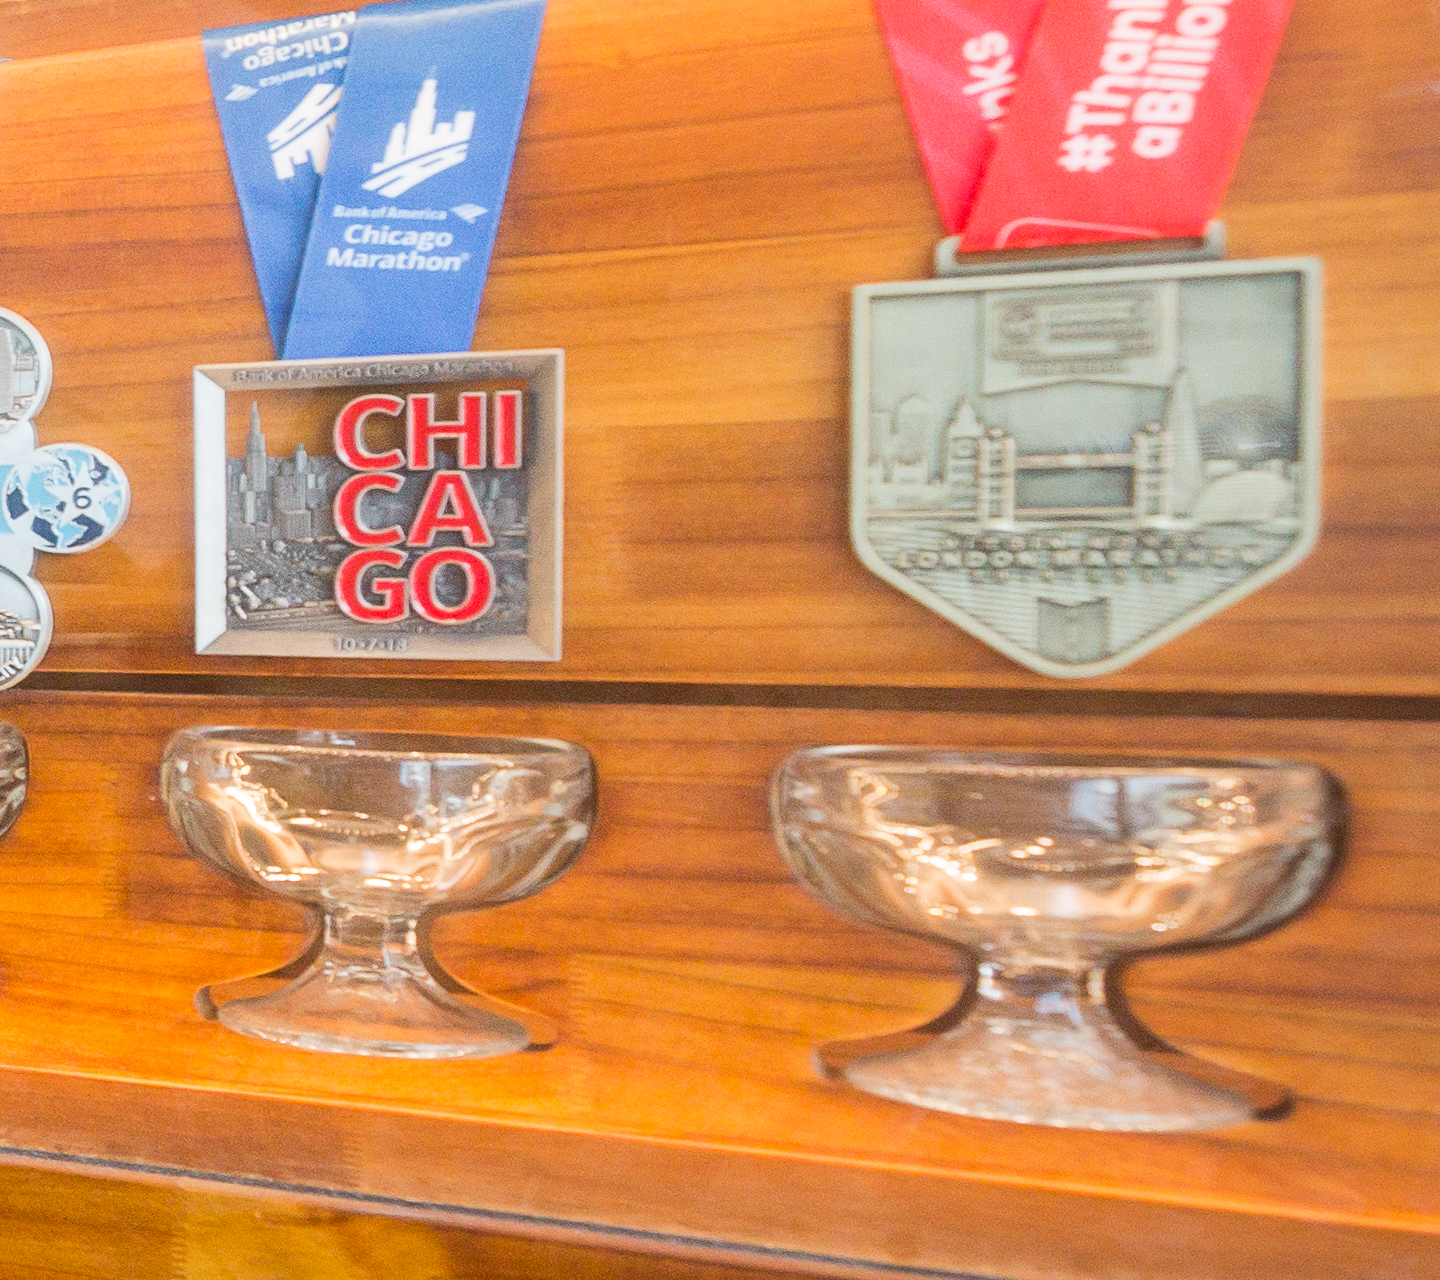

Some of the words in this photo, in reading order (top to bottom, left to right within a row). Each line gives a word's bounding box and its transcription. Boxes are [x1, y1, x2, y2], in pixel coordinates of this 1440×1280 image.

[224, 11, 357, 52] Marathon
[243, 31, 349, 70] Chicago
[333, 204, 368, 219] Bank
[386, 206, 448, 221] America
[344, 223, 454, 251] Chicago
[326, 247, 464, 271] Marathon
[333, 389, 523, 471] CHI
[73, 486, 92, 510] 6
[333, 470, 495, 548] CA
[334, 546, 497, 625] GO
